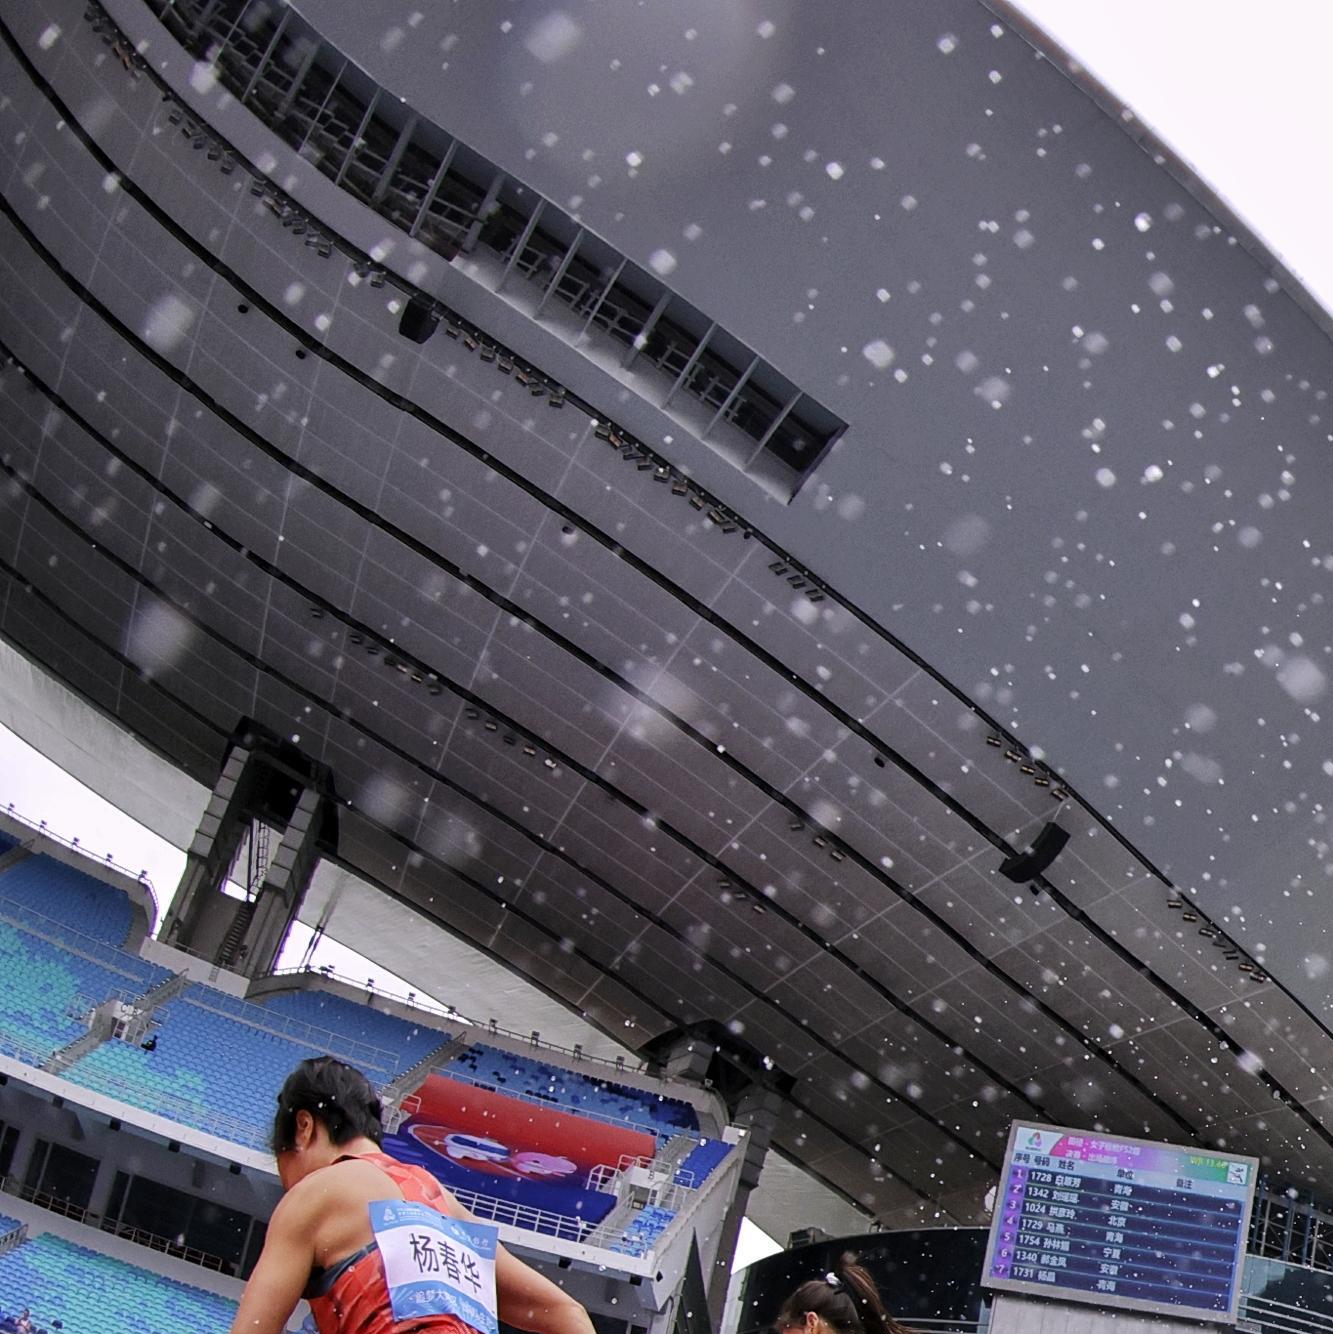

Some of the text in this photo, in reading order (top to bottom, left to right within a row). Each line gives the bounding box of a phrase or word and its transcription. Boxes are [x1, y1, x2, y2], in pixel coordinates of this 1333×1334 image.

[1058, 1158, 1075, 1171] 姓名
[1031, 1171, 1052, 1183] 1728
[1028, 1186, 1049, 1199] 1342
[1025, 1202, 1046, 1215] 1024
[1022, 1218, 1043, 1230] 1729
[1019, 1234, 1040, 1247] 1754
[409, 1232, 482, 1294] 杨春华
[1016, 1250, 1037, 1263] 1340
[1013, 1266, 1034, 1279] 1731
